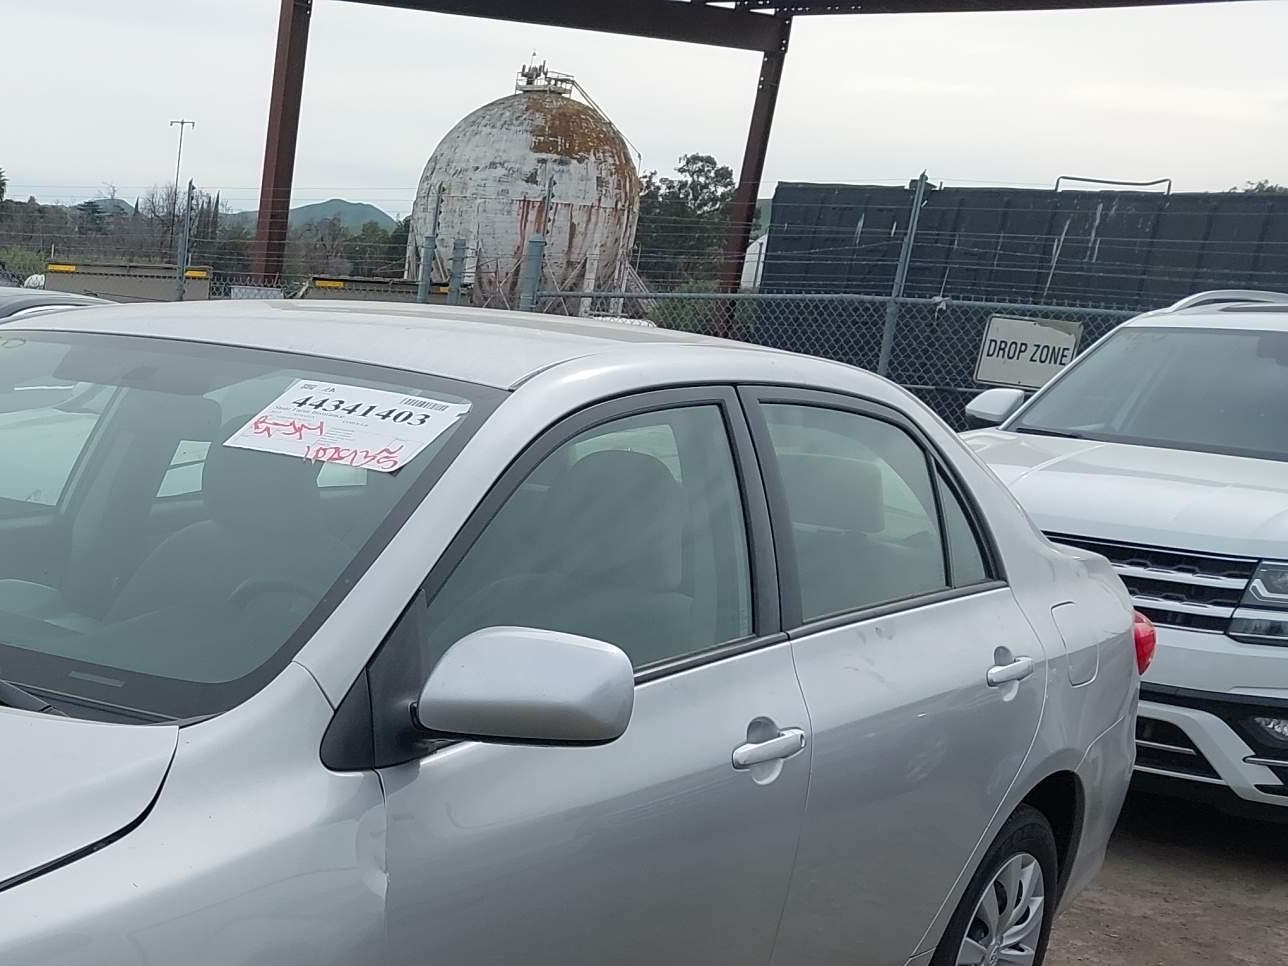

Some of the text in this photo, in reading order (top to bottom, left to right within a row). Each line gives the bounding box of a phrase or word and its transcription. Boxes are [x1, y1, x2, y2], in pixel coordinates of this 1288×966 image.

[986, 339, 1070, 366] DROP ZONE
[292, 395, 431, 427] 44341403
